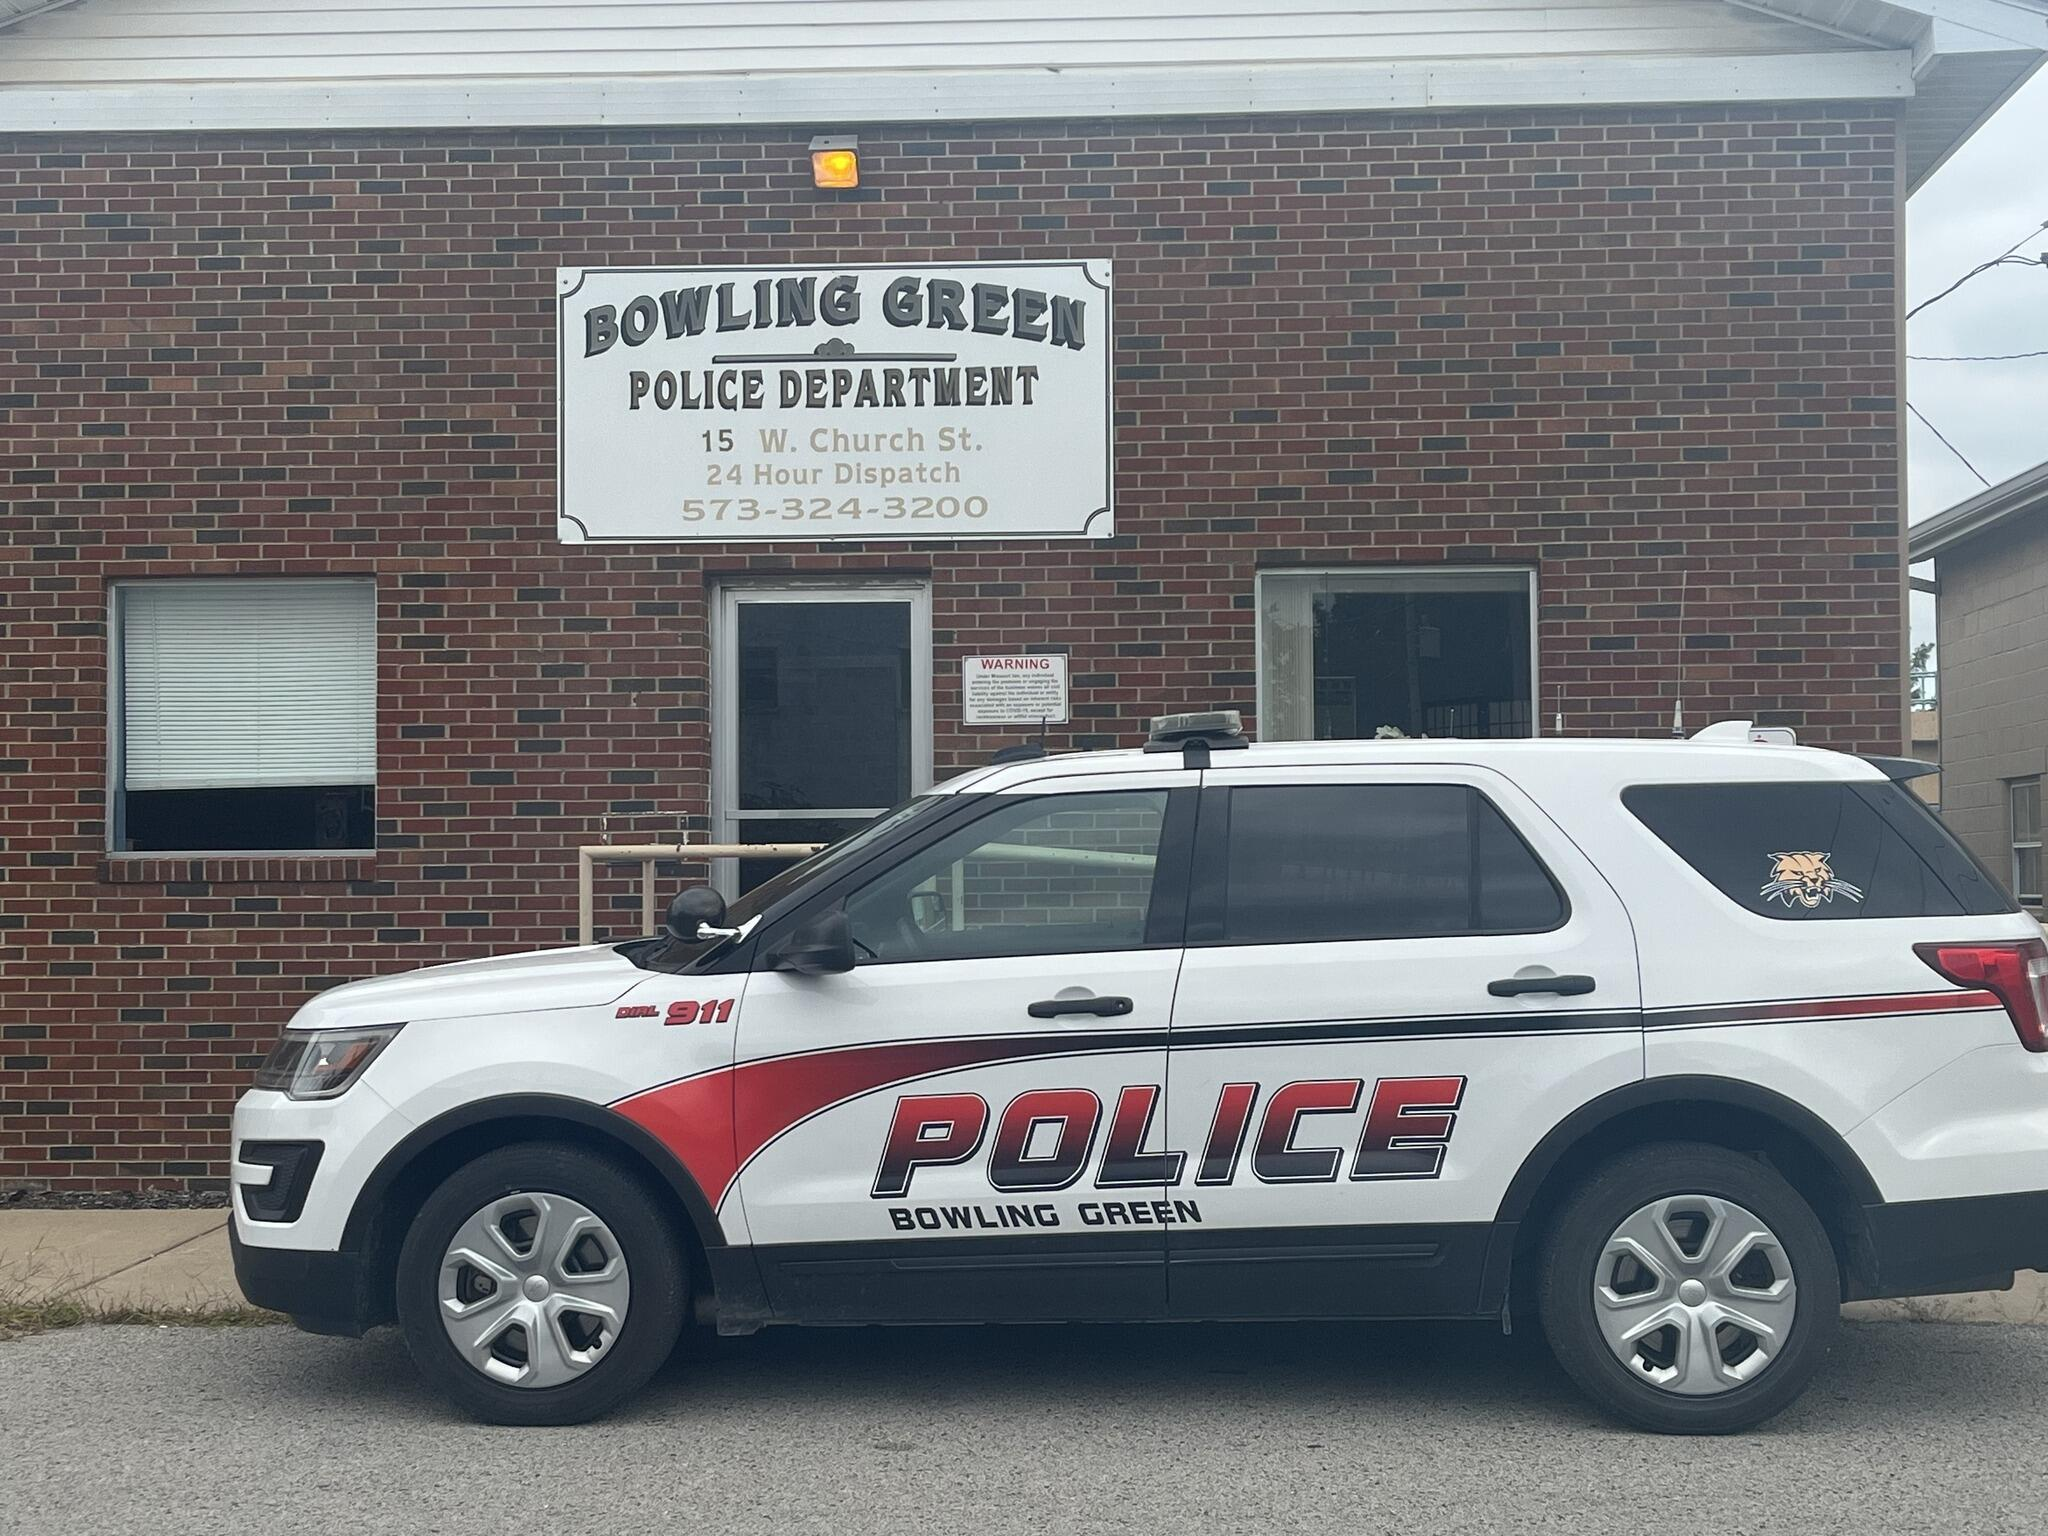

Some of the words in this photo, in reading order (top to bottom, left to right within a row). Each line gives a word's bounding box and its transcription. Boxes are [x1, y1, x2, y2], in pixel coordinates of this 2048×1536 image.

[584, 275, 861, 358] BOWLING
[883, 276, 1086, 352] GREEN
[629, 369, 765, 411] POLICE
[779, 365, 1040, 409] DEPARTMENT
[702, 429, 734, 453] 15
[759, 428, 798, 453] W.
[809, 427, 929, 453] Church
[937, 427, 983, 452] St.
[706, 464, 743, 486] 24
[754, 464, 823, 486] Hour
[835, 461, 961, 489] Dispatch
[681, 495, 990, 522] 573-324-3200
[981, 658, 1050, 670] WARNING
[615, 1005, 660, 1019] DIAL
[664, 998, 735, 1026] 911
[870, 1074, 1468, 1200] POLICE
[888, 1202, 1061, 1232] BOWLING
[1077, 1199, 1203, 1225] GREEN
